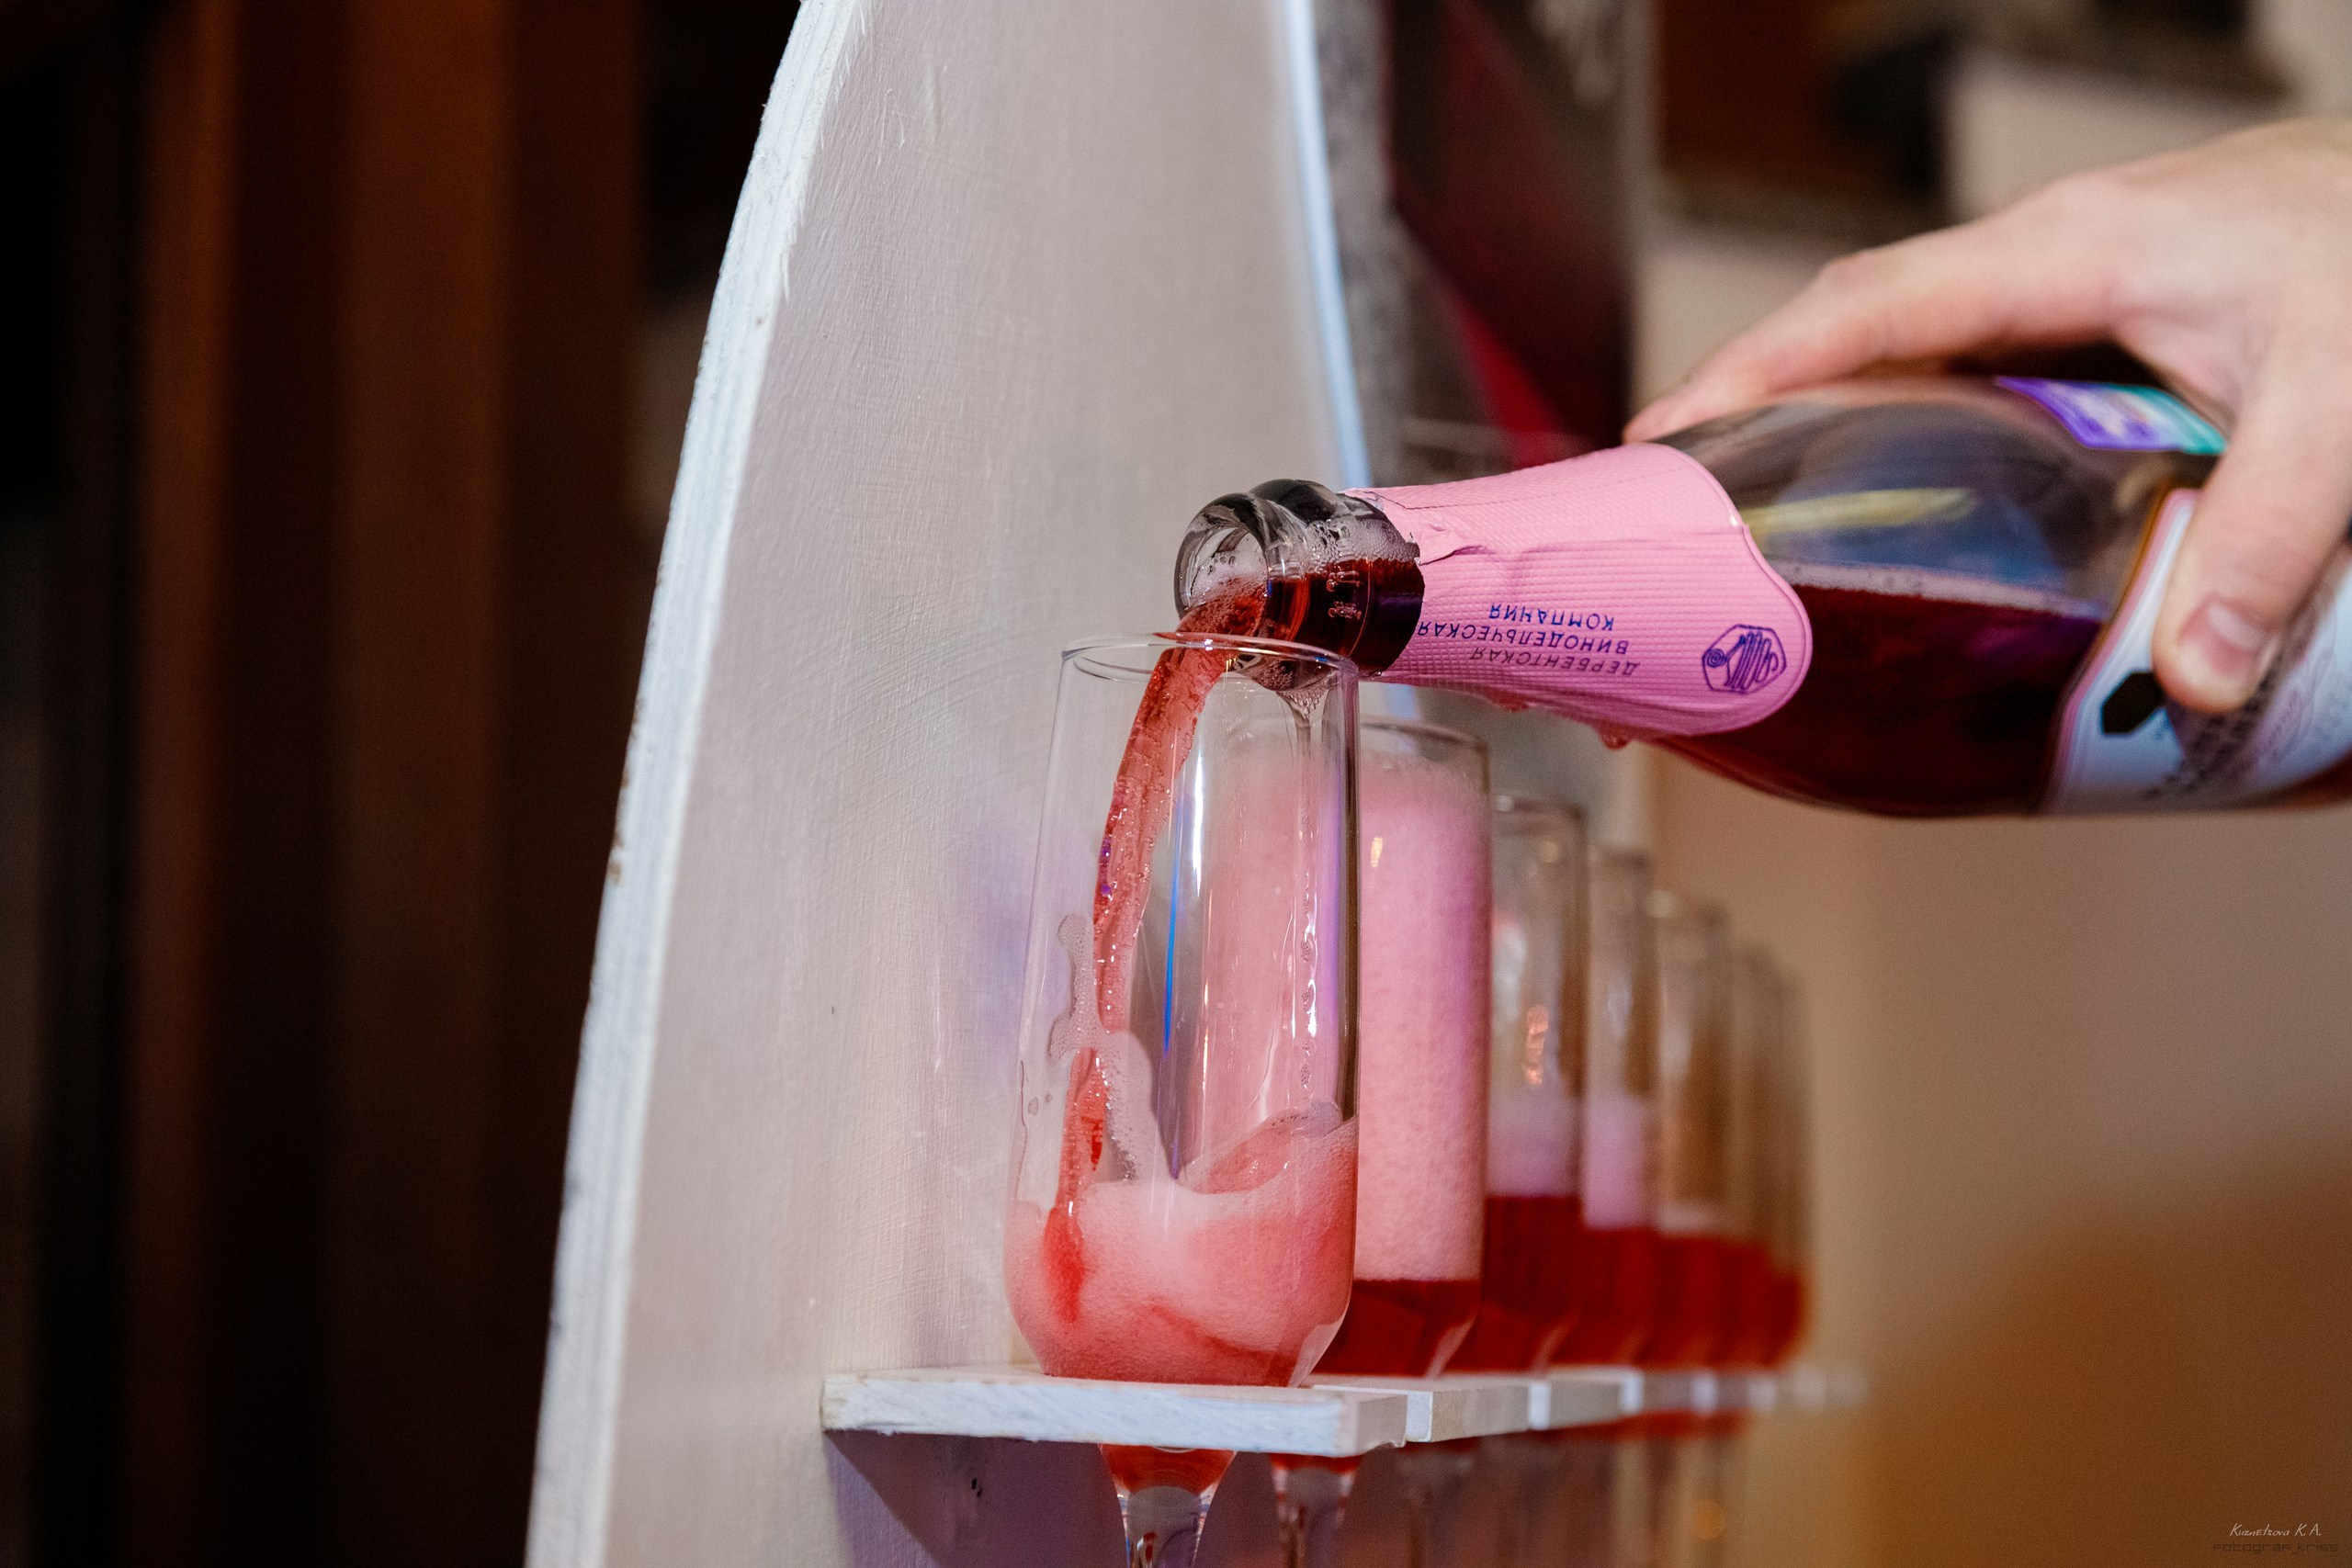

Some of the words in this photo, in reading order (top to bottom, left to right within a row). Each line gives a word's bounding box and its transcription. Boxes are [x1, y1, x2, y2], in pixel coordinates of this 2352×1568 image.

[1488, 603, 1615, 632] КОМПАНИЯ
[1417, 620, 1629, 655] ВИНОДЕЛЬЧЕСКАЯ
[1470, 647, 1640, 676] ДЕРБЕНТСКАЯ
